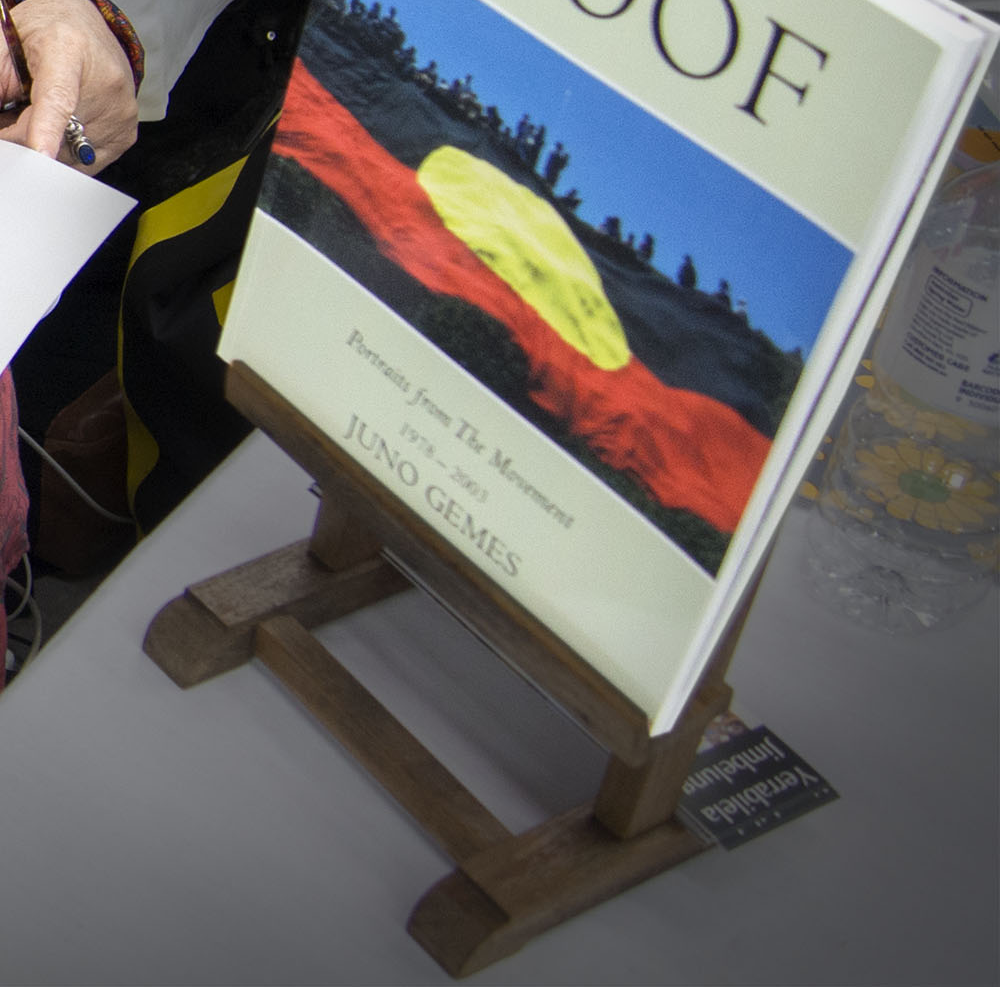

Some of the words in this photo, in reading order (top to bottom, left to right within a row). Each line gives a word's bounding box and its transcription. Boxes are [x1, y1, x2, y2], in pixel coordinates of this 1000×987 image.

[932, 265, 989, 303] INFORMATION
[346, 329, 411, 393] Portraits
[407, 388, 453, 428] from
[454, 418, 486, 455] The
[488, 448, 576, 531] Movement
[399, 421, 435, 459] 1978
[343, 413, 420, 487] JUNO
[424, 484, 522, 578] GEMES
[701, 766, 819, 824] Yerrabilela
